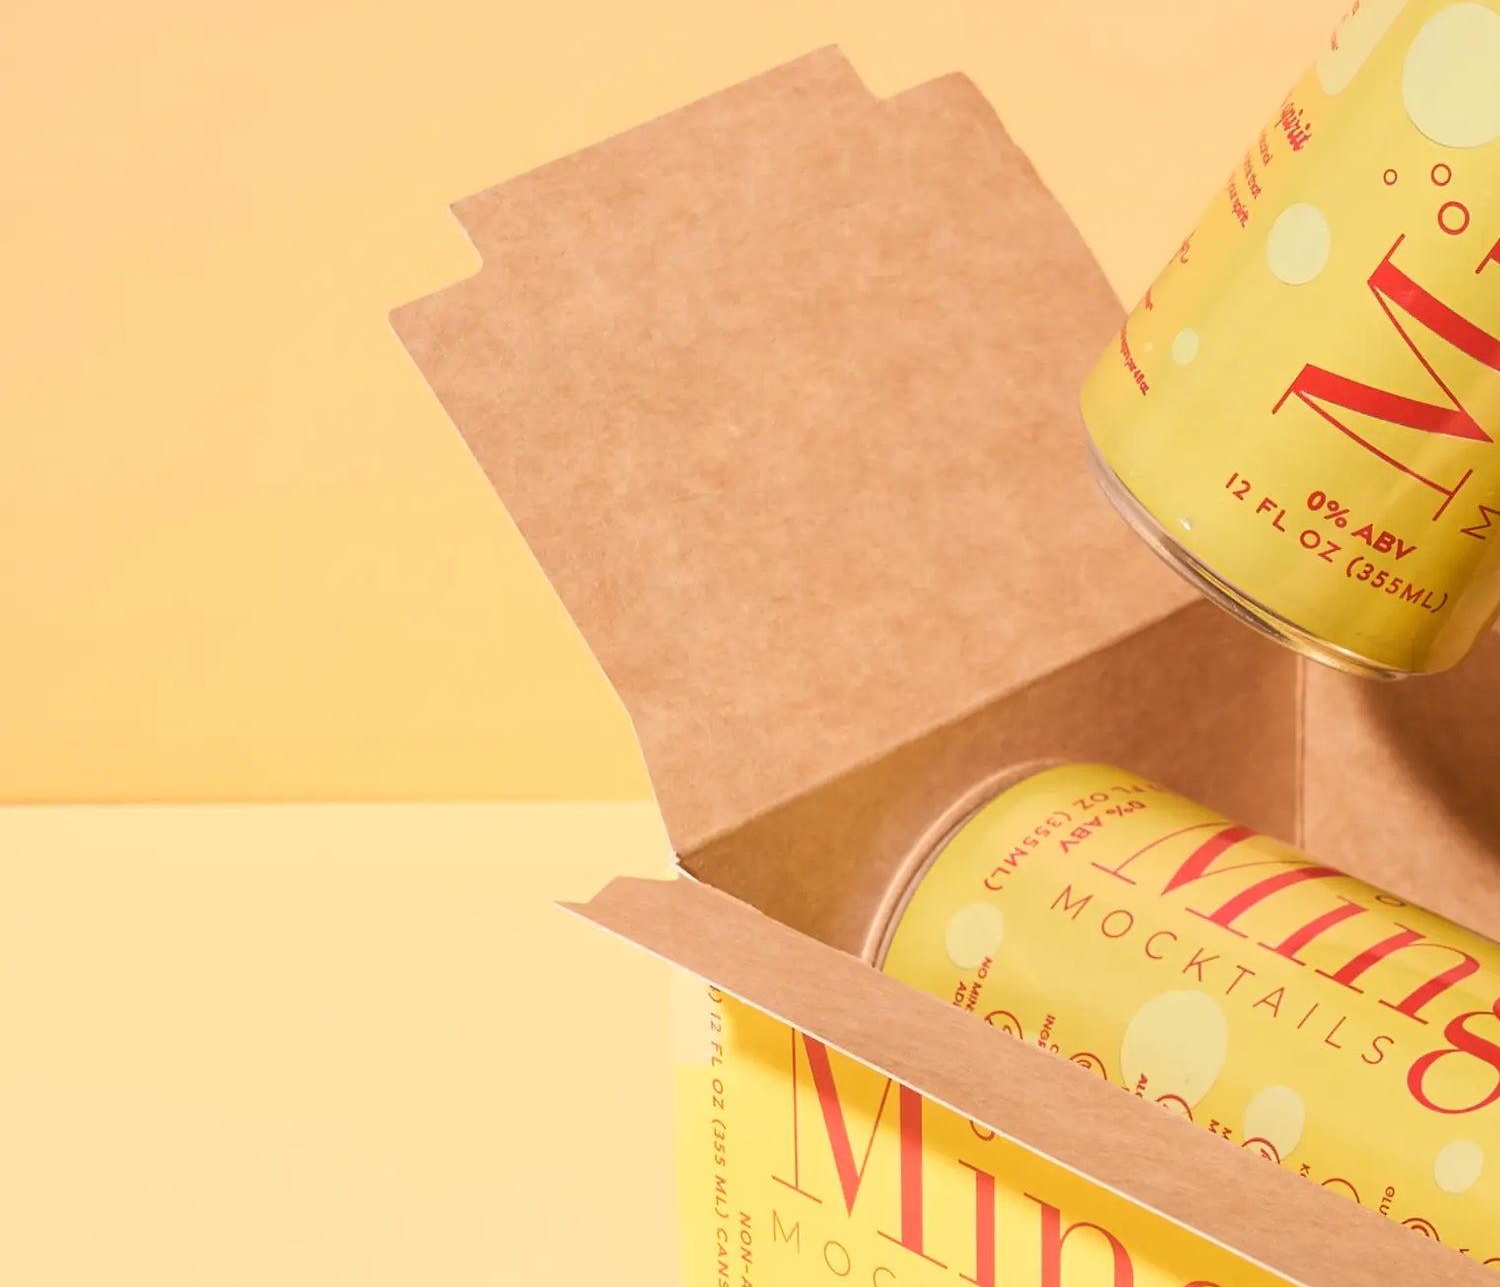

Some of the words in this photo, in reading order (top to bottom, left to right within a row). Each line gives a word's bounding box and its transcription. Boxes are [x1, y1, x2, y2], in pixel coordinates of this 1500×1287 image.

[1225, 472, 1252, 501] 12
[1255, 497, 1286, 533] FL
[1299, 529, 1343, 563] OZ
[1345, 555, 1449, 614] (355ML)
[1306, 490, 1351, 529] 0%
[1350, 522, 1418, 561] ABV
[983, 810, 1073, 891] (355ML)
[1059, 815, 1104, 854] ABV
[1050, 884, 1396, 1066] MOCKTAILS
